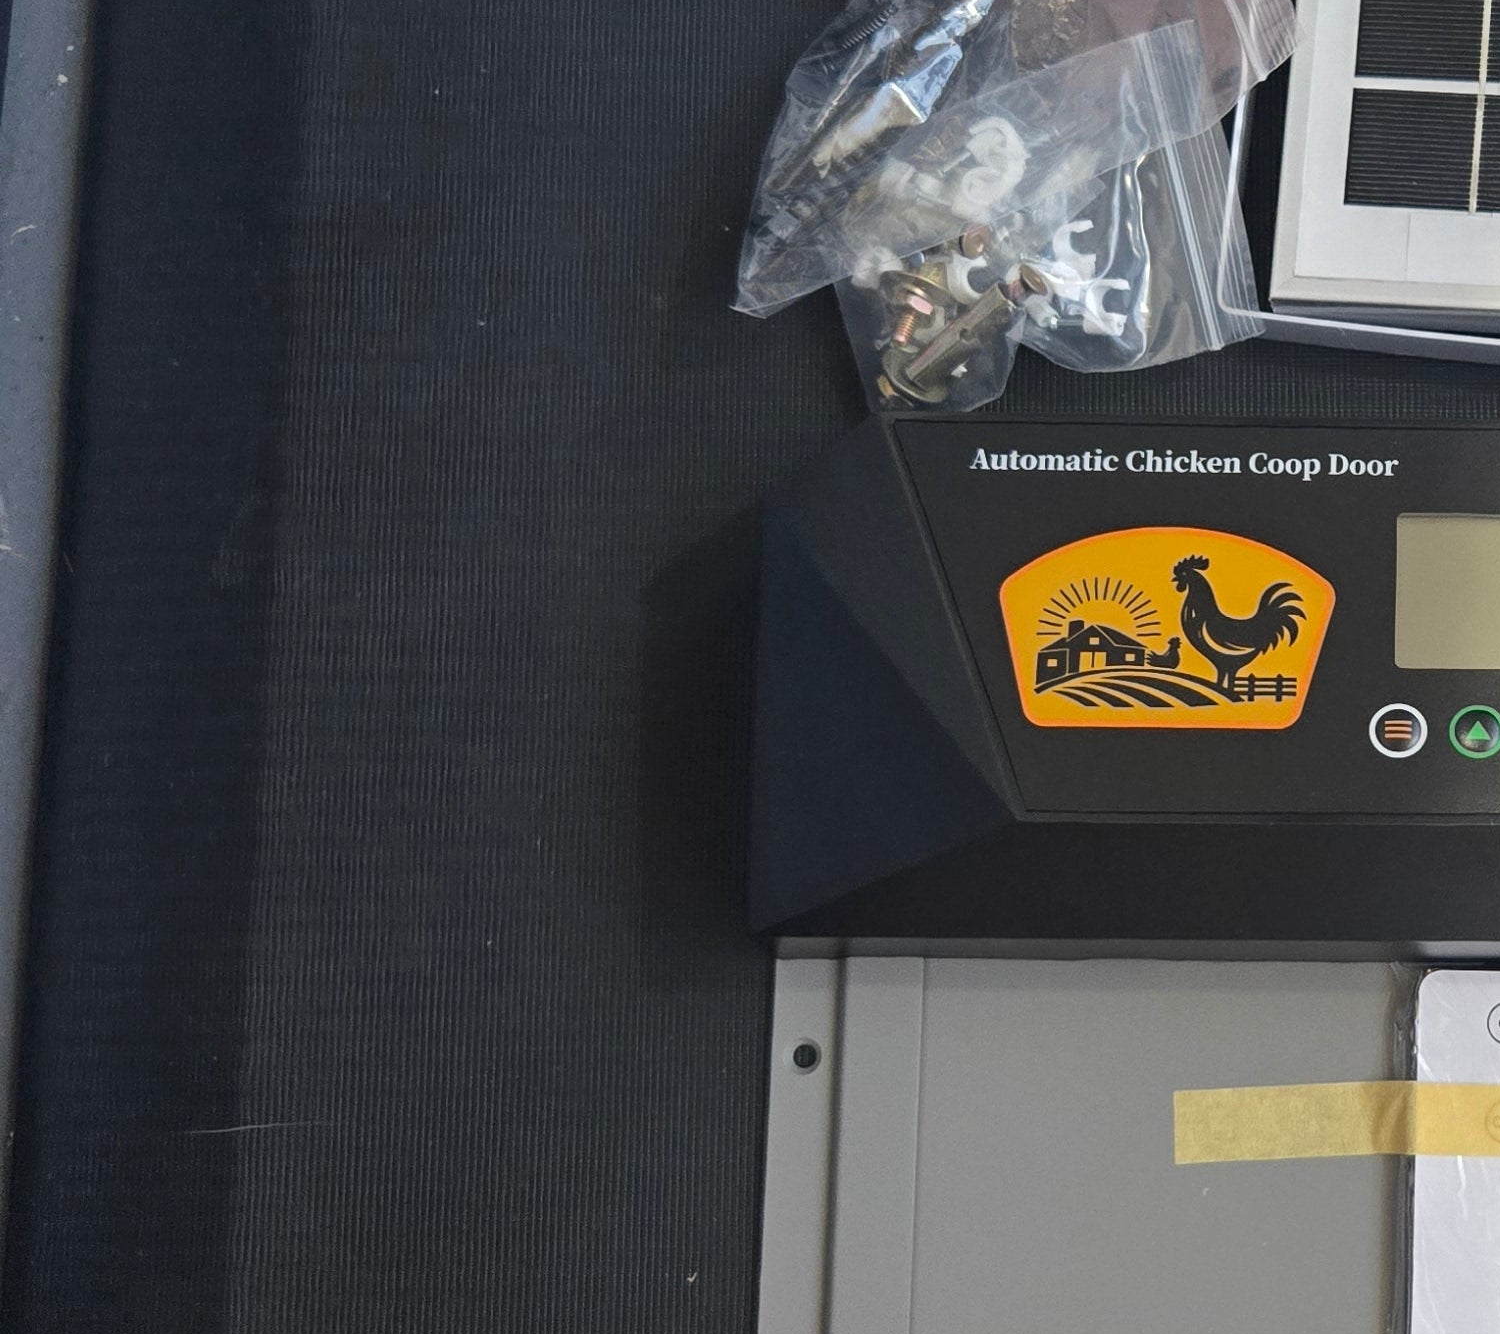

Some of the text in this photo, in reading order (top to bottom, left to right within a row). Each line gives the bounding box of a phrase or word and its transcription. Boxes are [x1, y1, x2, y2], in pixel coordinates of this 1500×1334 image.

[969, 448, 1400, 482] Automatic Chicken Coop Door
